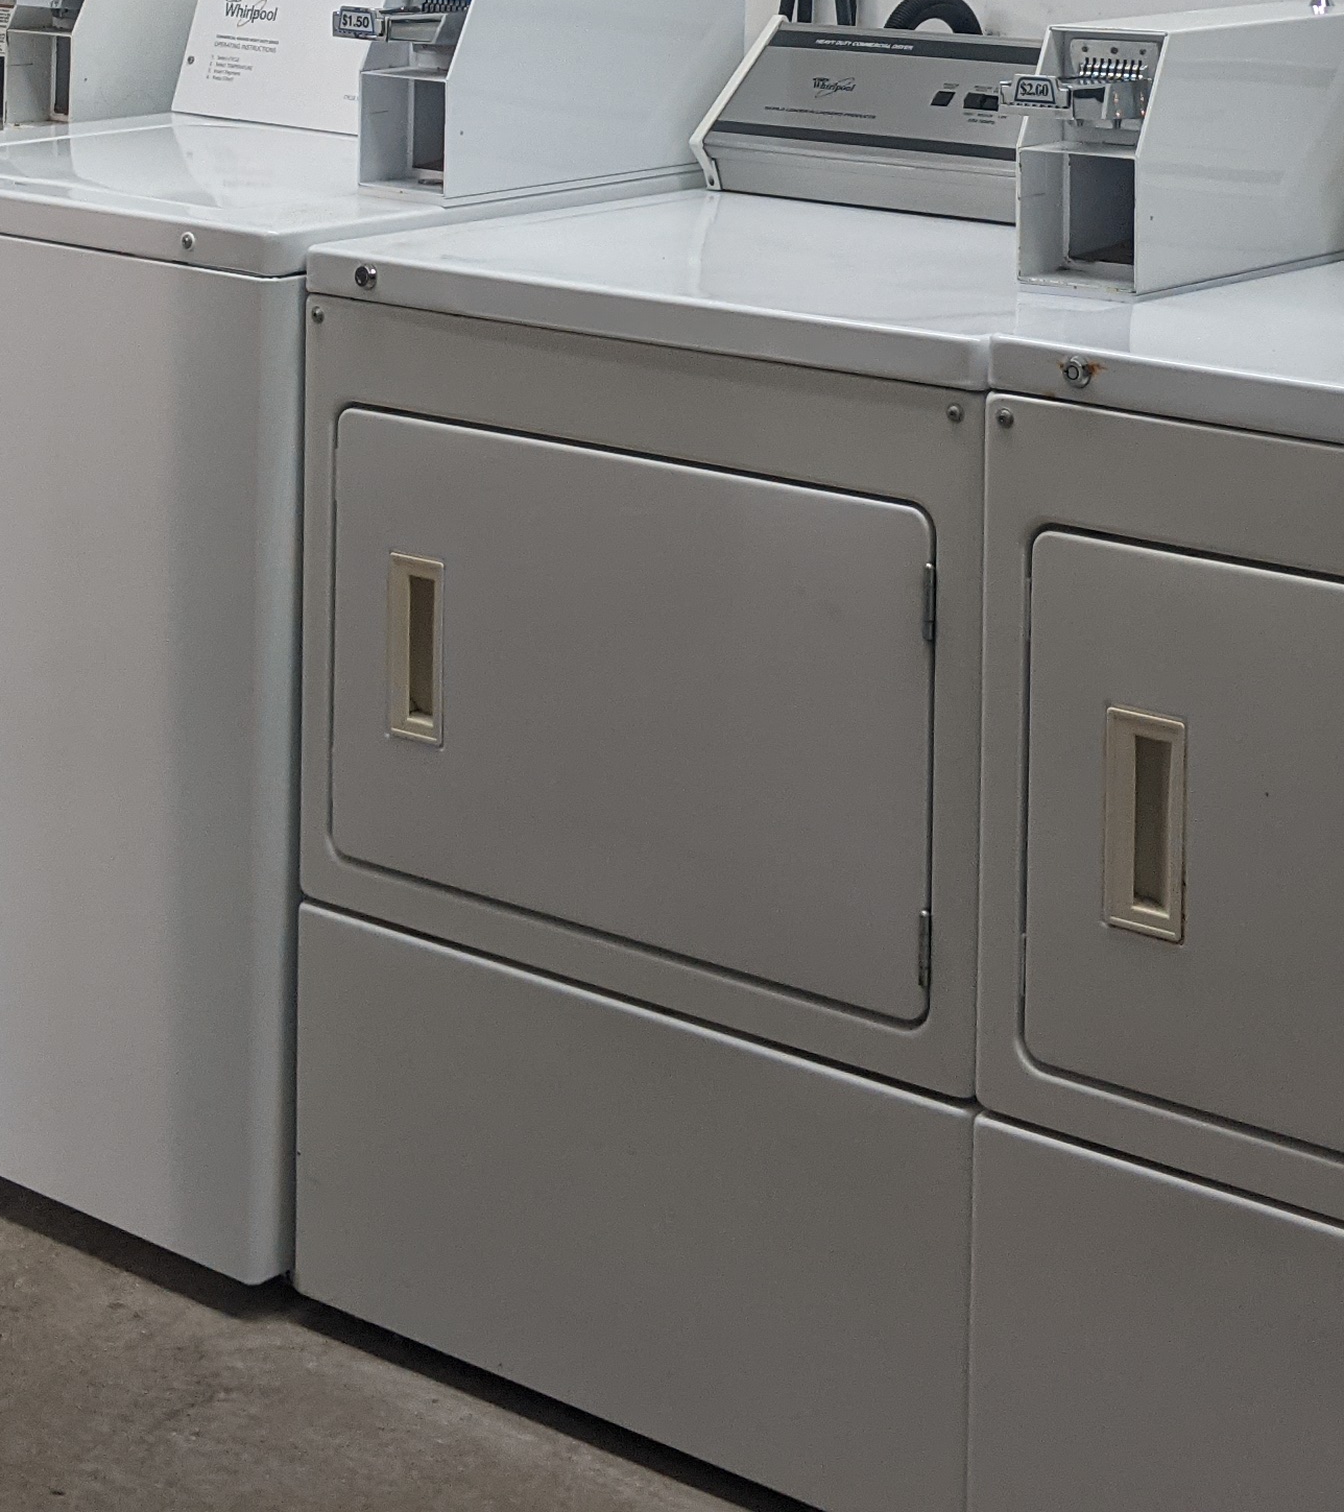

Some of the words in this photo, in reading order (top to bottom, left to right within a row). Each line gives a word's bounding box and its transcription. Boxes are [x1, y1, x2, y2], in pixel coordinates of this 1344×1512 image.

[225, 1, 278, 24] Whirlpool
[342, 14, 369, 28] $1.50
[813, 78, 856, 93] Whirlpool
